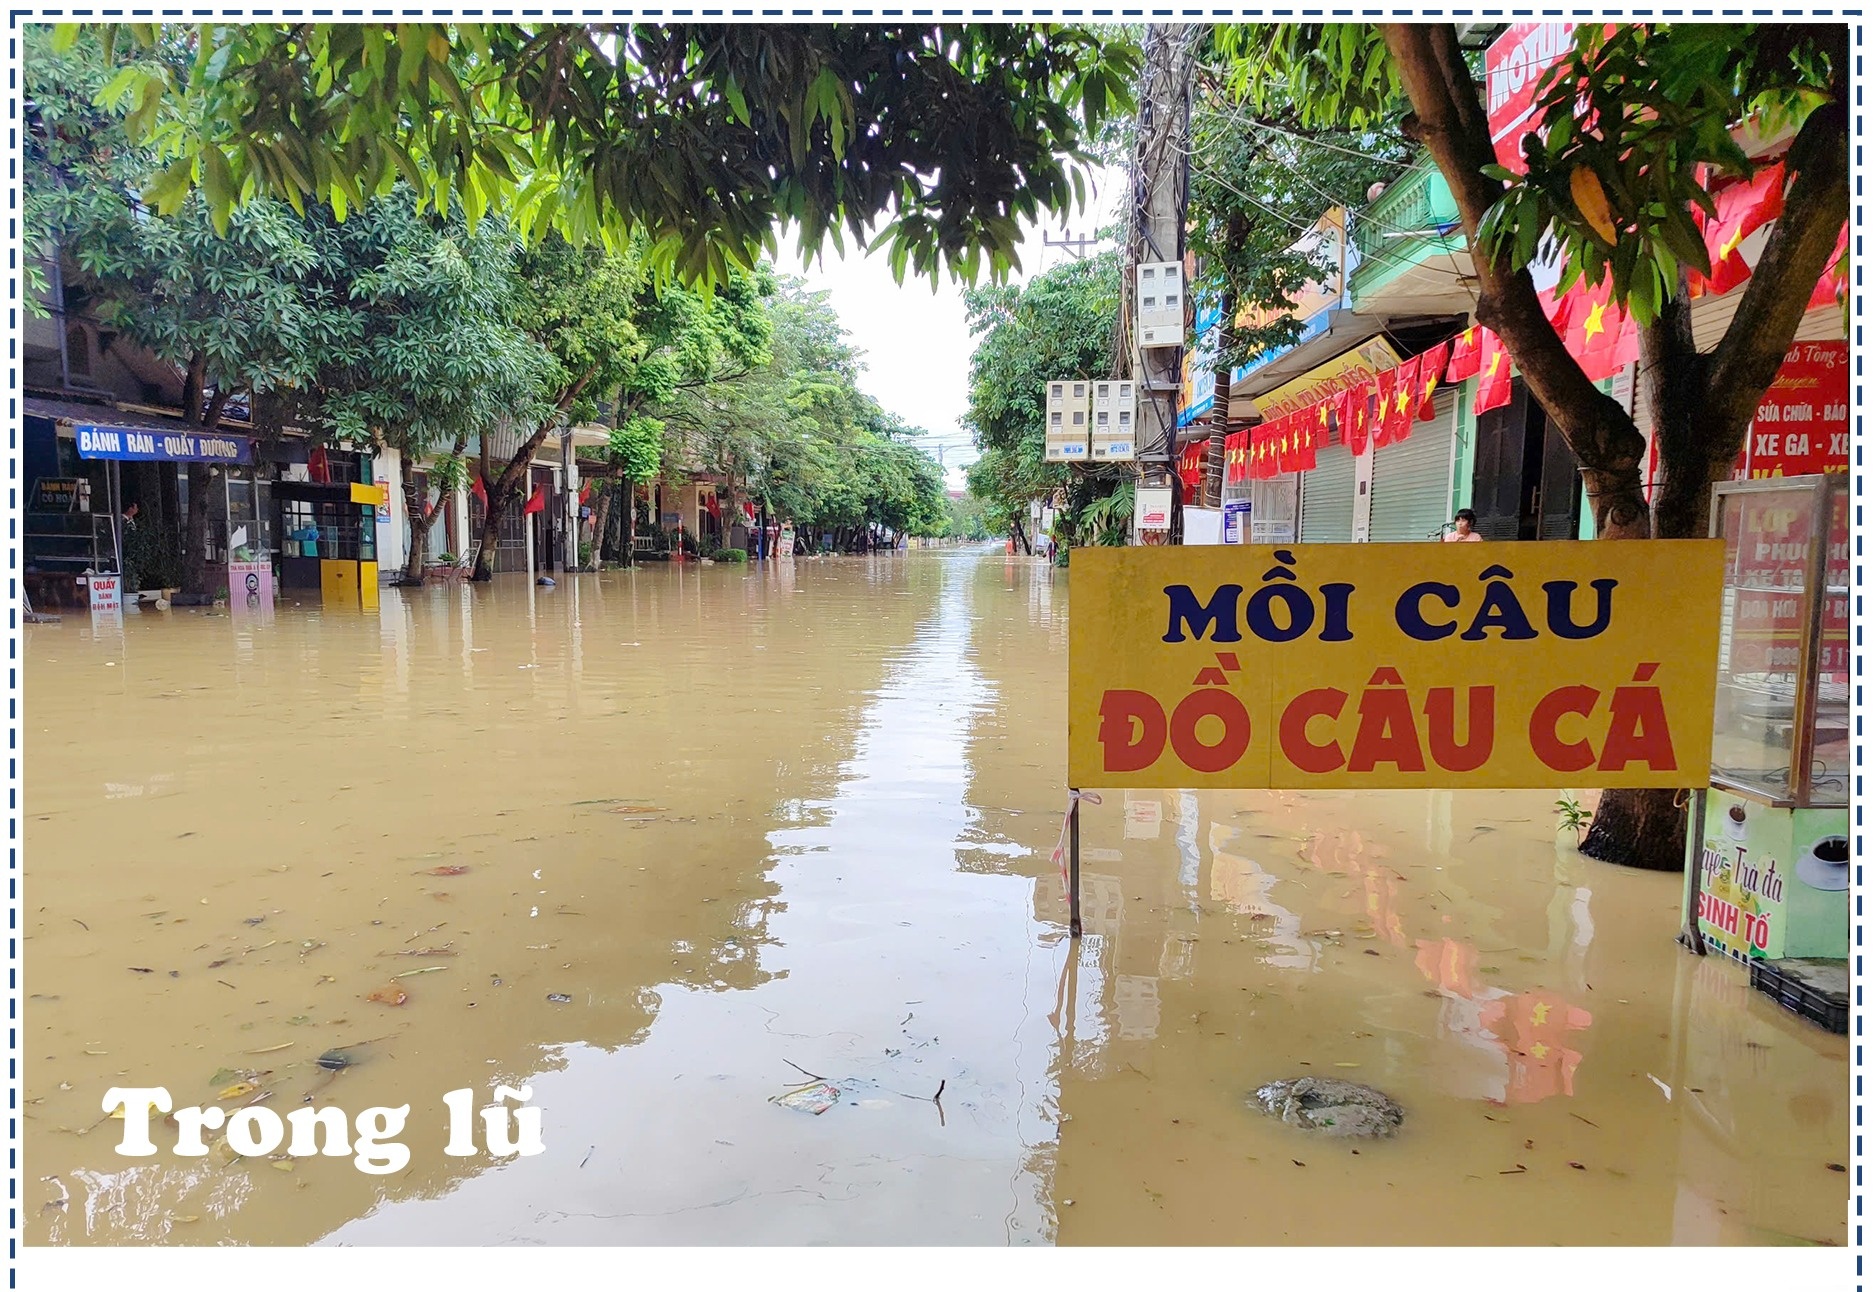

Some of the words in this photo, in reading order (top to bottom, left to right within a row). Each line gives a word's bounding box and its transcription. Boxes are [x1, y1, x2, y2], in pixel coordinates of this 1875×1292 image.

[1757, 400, 1780, 422] SỬA
[1783, 401, 1813, 422] CHỮA
[80, 428, 121, 452] BÁNH
[126, 431, 155, 453] RÁN
[1754, 434, 1780, 456] XE
[1785, 433, 1809, 455] GA
[1161, 550, 1356, 643] MỒI
[1394, 564, 1619, 641] CÂU
[1098, 652, 1252, 773] ĐỒ
[1278, 666, 1495, 774] CÂU
[1528, 663, 1678, 772] CÁ
[1697, 890, 1739, 935] SINH
[1745, 912, 1771, 949] TỐ
